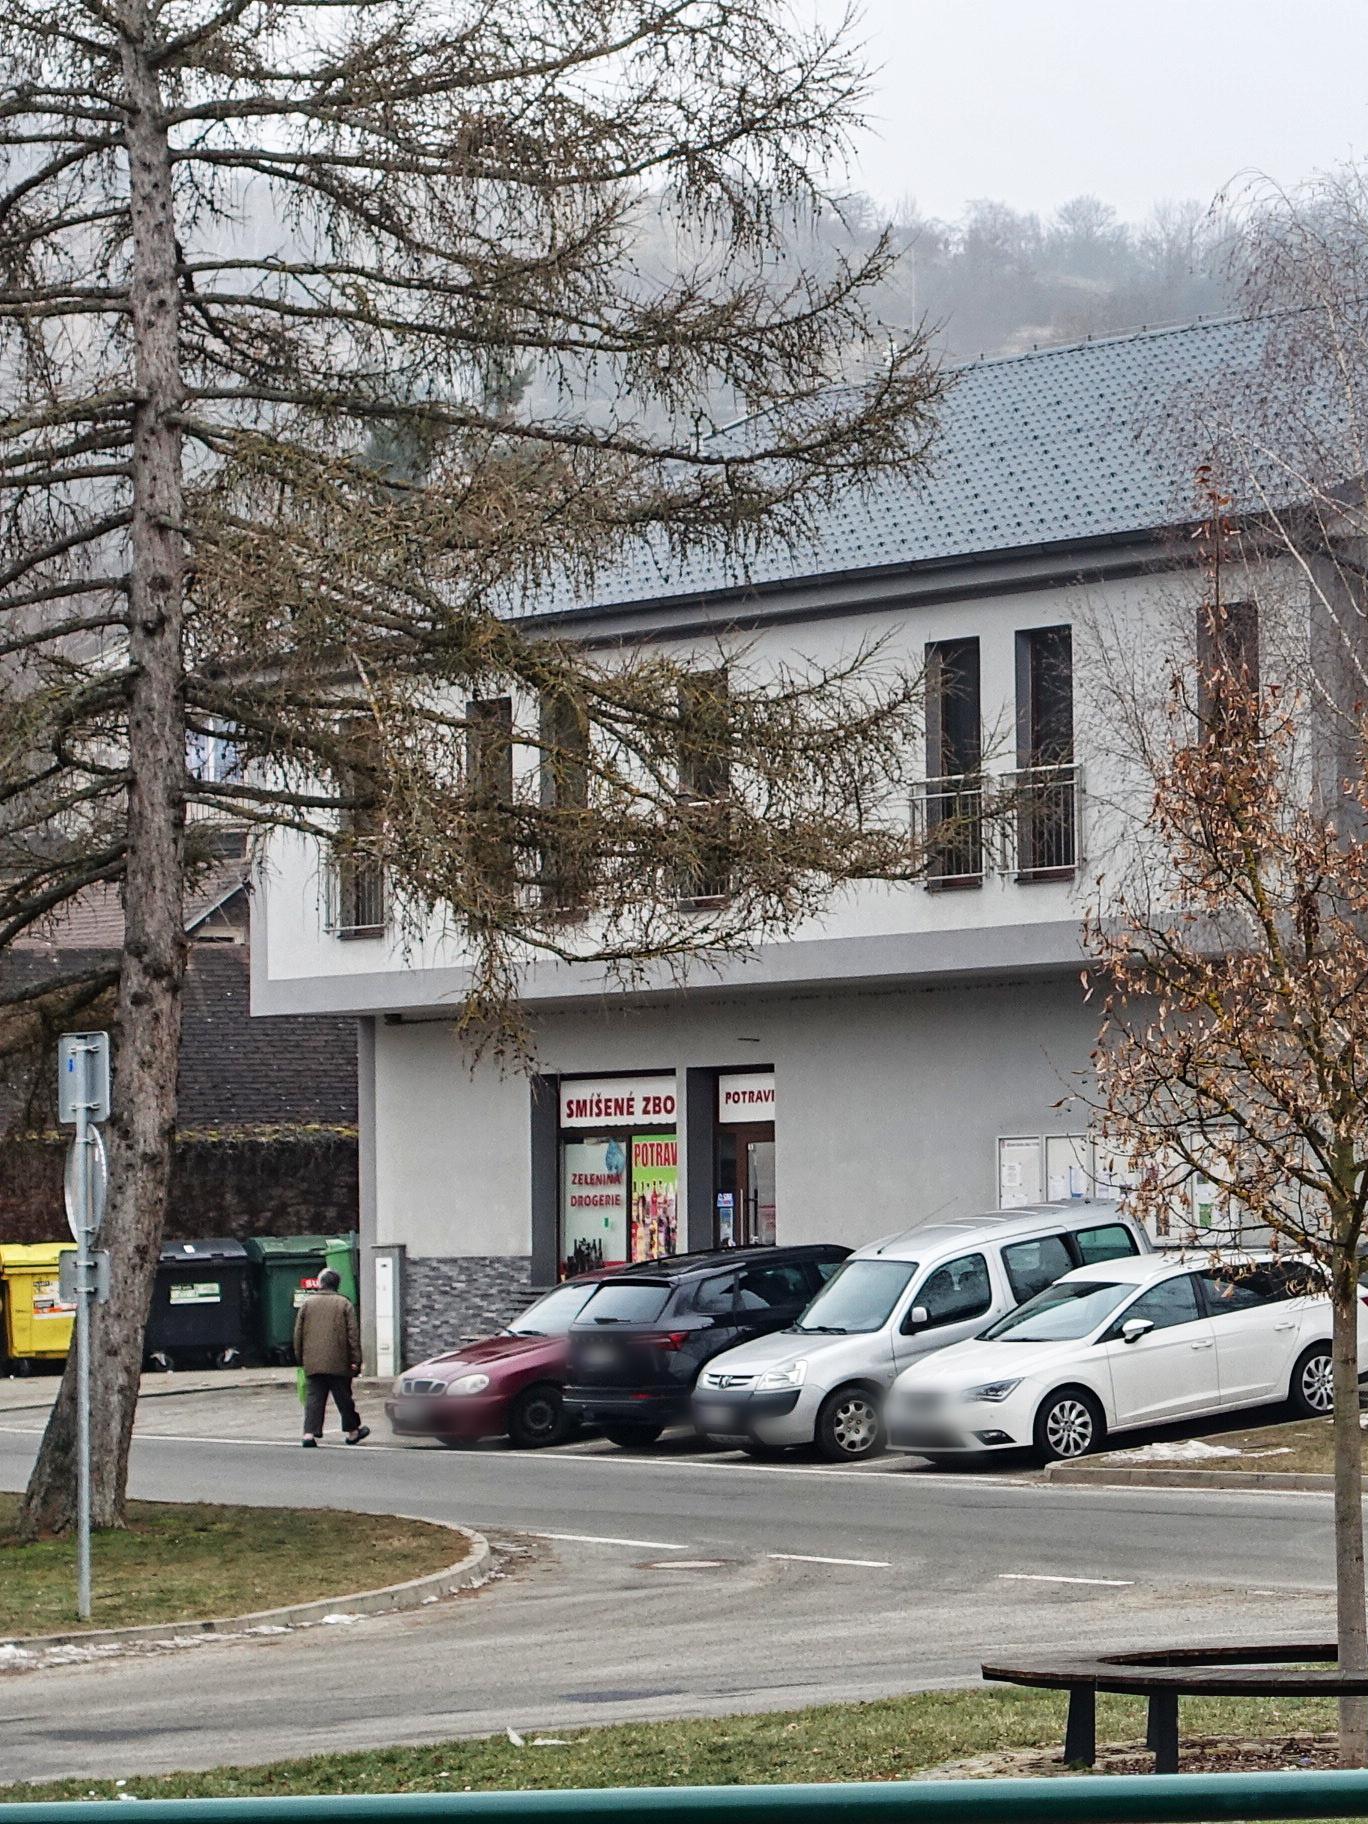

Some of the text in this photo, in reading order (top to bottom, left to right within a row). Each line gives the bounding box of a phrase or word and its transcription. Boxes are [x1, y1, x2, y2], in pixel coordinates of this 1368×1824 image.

[725, 1090, 774, 1104] POTRAVI
[566, 1091, 675, 1118] SMÍŠENÉ ZBO
[634, 1142, 677, 1167] POTRAV
[571, 1173, 623, 1186] ZELENINA
[570, 1194, 621, 1207] DROGERIE
